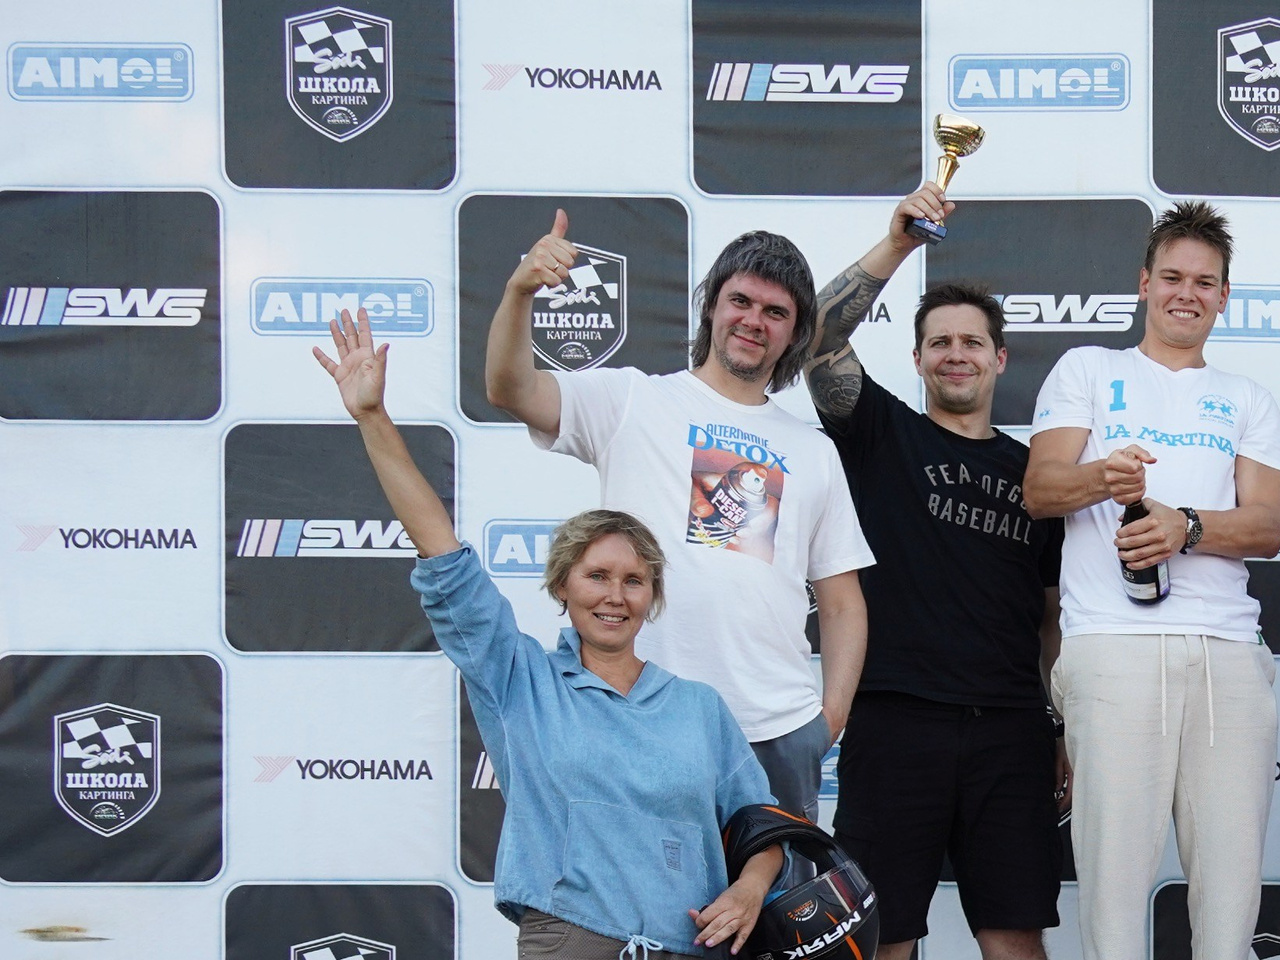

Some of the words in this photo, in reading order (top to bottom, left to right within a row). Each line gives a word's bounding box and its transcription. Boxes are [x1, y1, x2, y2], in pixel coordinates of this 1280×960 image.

[18, 57, 183, 88] AIMOL
[299, 77, 380, 93] ШКОЛА
[525, 67, 662, 91] YOKOHAMA
[766, 64, 910, 102] SWS
[959, 68, 1119, 98] AIMOL
[312, 95, 367, 105] КАРТИНГА
[63, 288, 207, 326] SWS
[260, 291, 423, 323] AIMOL
[1000, 295, 1139, 332] SWS
[534, 313, 614, 329] ШКОЛА
[547, 331, 602, 340] КАРТИНГА
[1109, 379, 1127, 412] 1
[687, 423, 792, 475] DETOX
[1104, 424, 1130, 440] LA
[1137, 426, 1235, 458] MARTINA
[924, 462, 979, 486] FEA
[928, 493, 1031, 545] BASEBALL
[59, 528, 197, 550] YOKOHAMA
[66, 773, 148, 788] ШКОЛА
[297, 759, 433, 781] YOKOHAMA
[80, 791, 135, 800] КАРТИНГА
